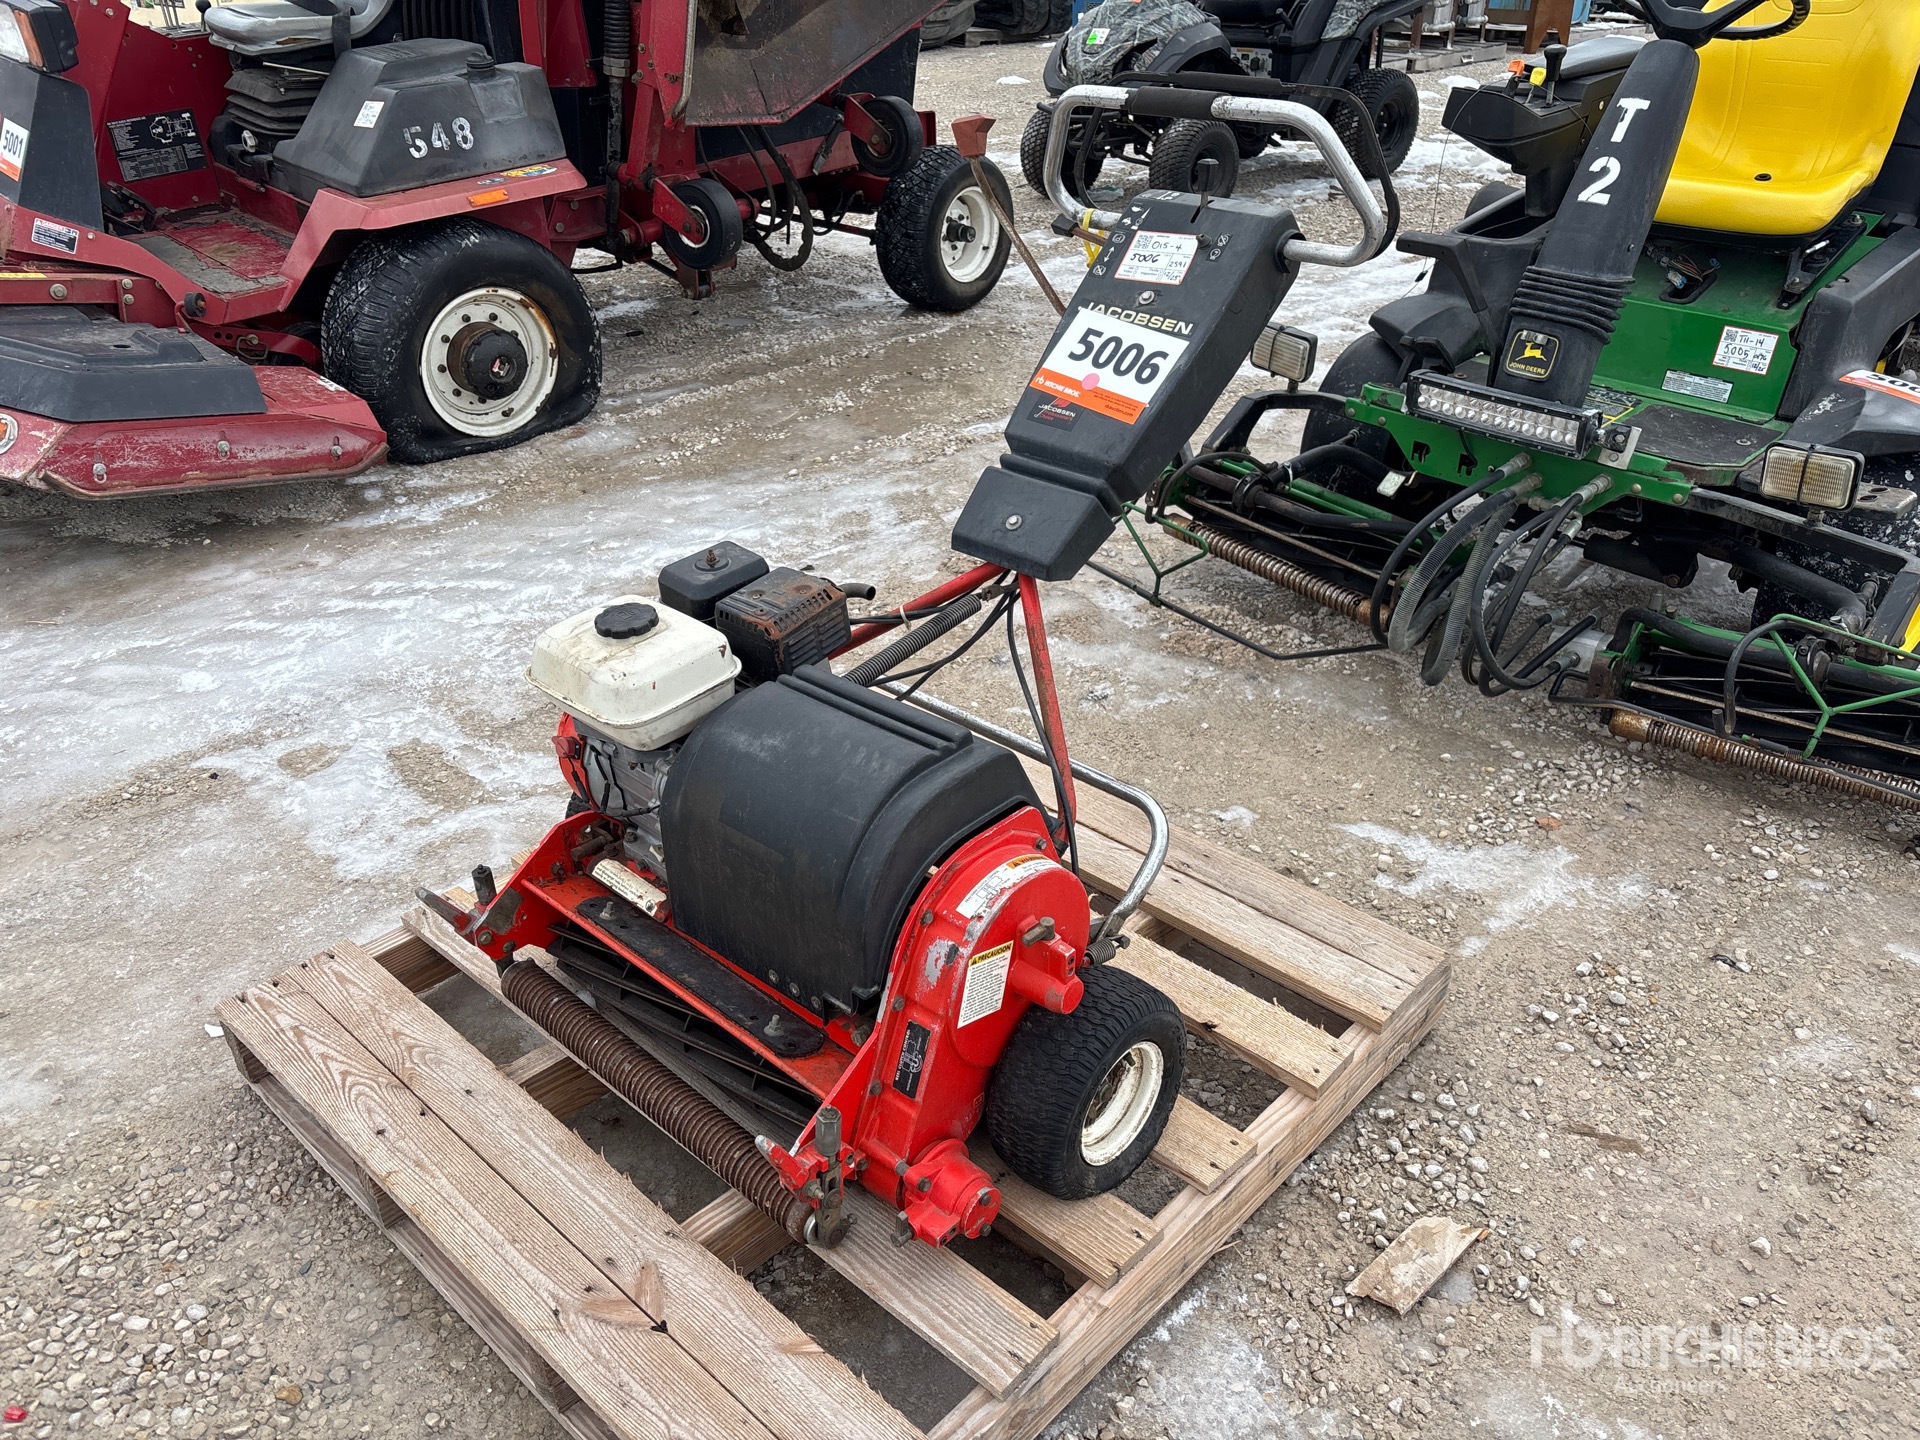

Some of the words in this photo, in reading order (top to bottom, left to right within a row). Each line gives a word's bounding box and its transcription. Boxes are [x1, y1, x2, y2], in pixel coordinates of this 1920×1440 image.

[1616, 97, 1651, 142] T
[3, 129, 24, 159] 5001
[403, 117, 474, 159] 548
[1577, 156, 1621, 206] 2
[1130, 252, 1161, 264] 5006
[1067, 327, 1170, 385] 5006
[1723, 343, 1750, 360] 5005
[1509, 361, 1526, 370] JOHN
[1525, 365, 1546, 375] DEERE
[1038, 403, 1077, 418] JACOBSEN
